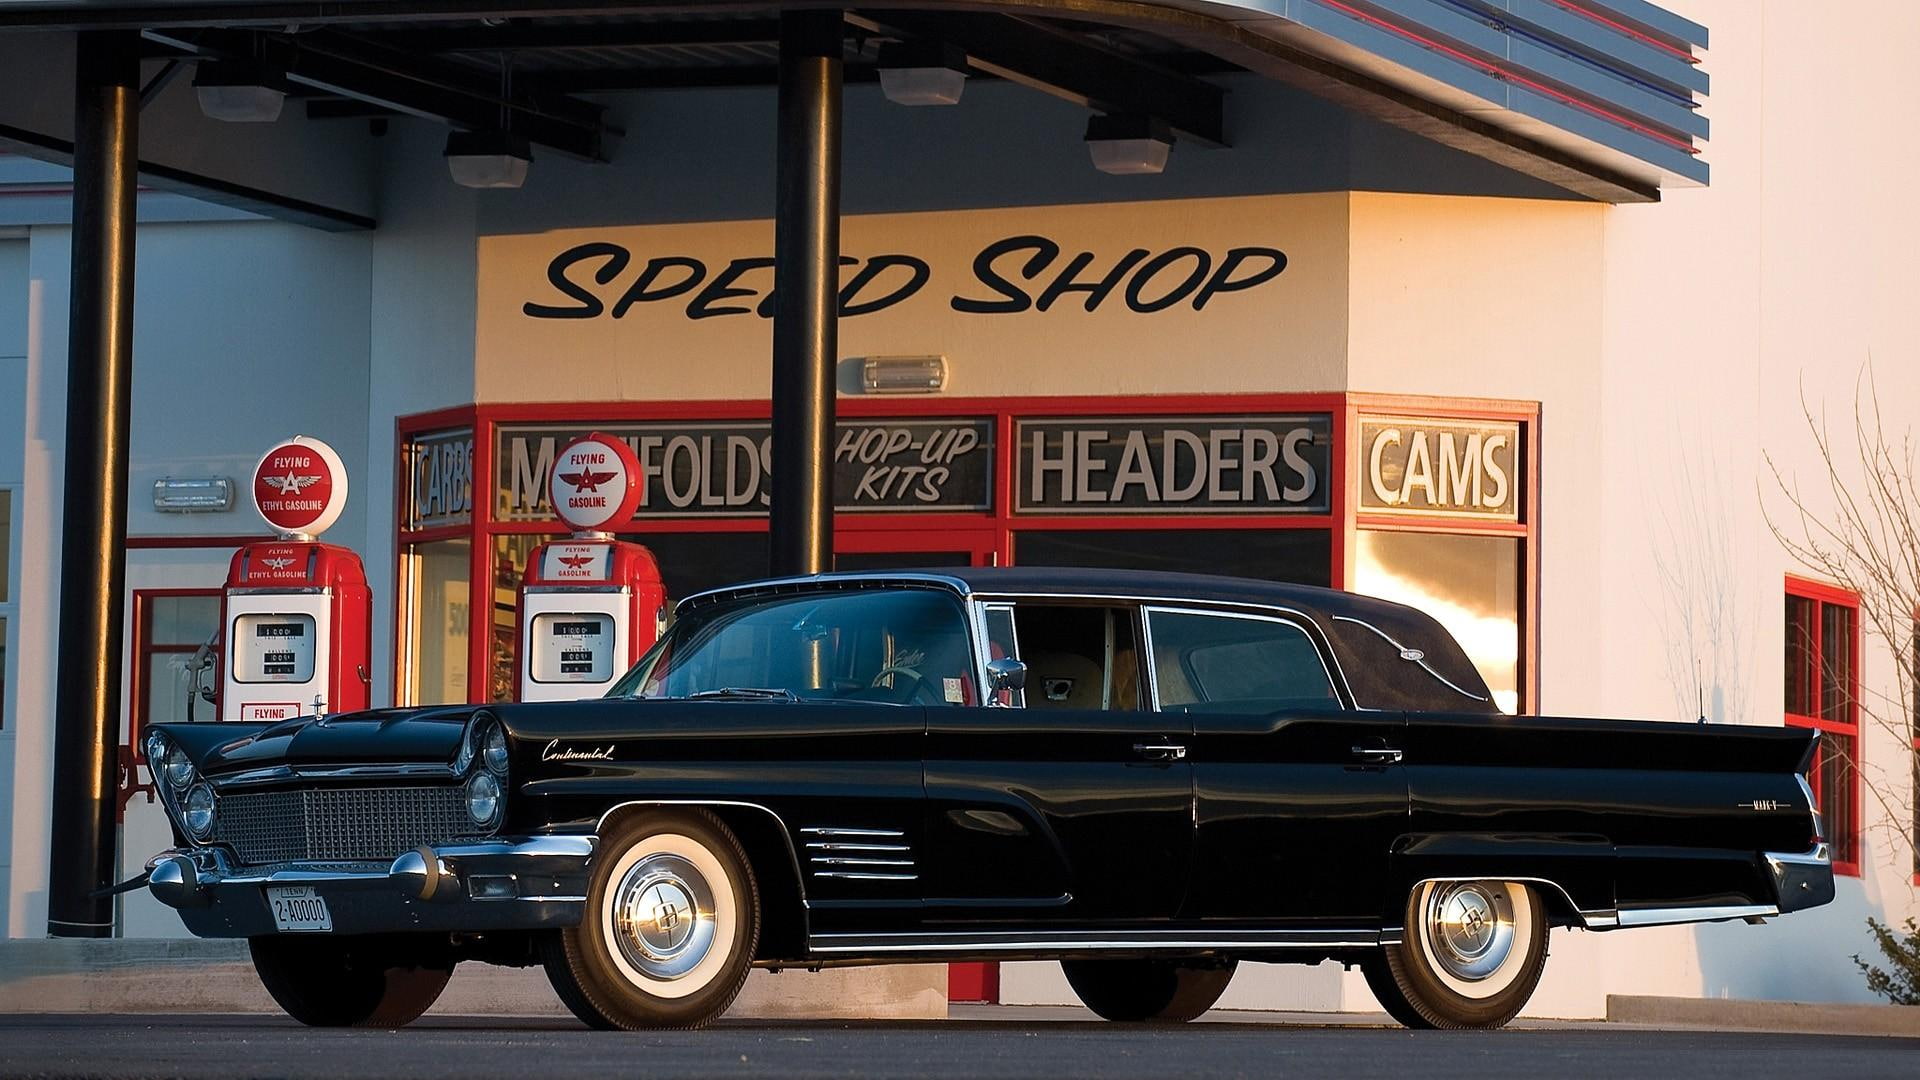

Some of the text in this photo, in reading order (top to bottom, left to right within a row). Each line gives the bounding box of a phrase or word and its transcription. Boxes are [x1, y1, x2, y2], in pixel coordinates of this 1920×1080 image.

[523, 235, 1287, 319] SPED SHOP
[835, 428, 979, 464] HOP-UP
[274, 457, 310, 469] FLYING
[571, 453, 606, 465] FLYING
[1032, 428, 1317, 503] HEADERS
[1370, 428, 1508, 508] CAMS
[511, 434, 772, 508] MFOLD
[855, 466, 949, 501] KITS
[262, 500, 323, 511] ETHYL GASOLINE
[568, 496, 606, 508] GASOLINE
[249, 571, 271, 579] ETHYL
[254, 708, 285, 719] FLYING
[542, 738, 615, 761] Continental
